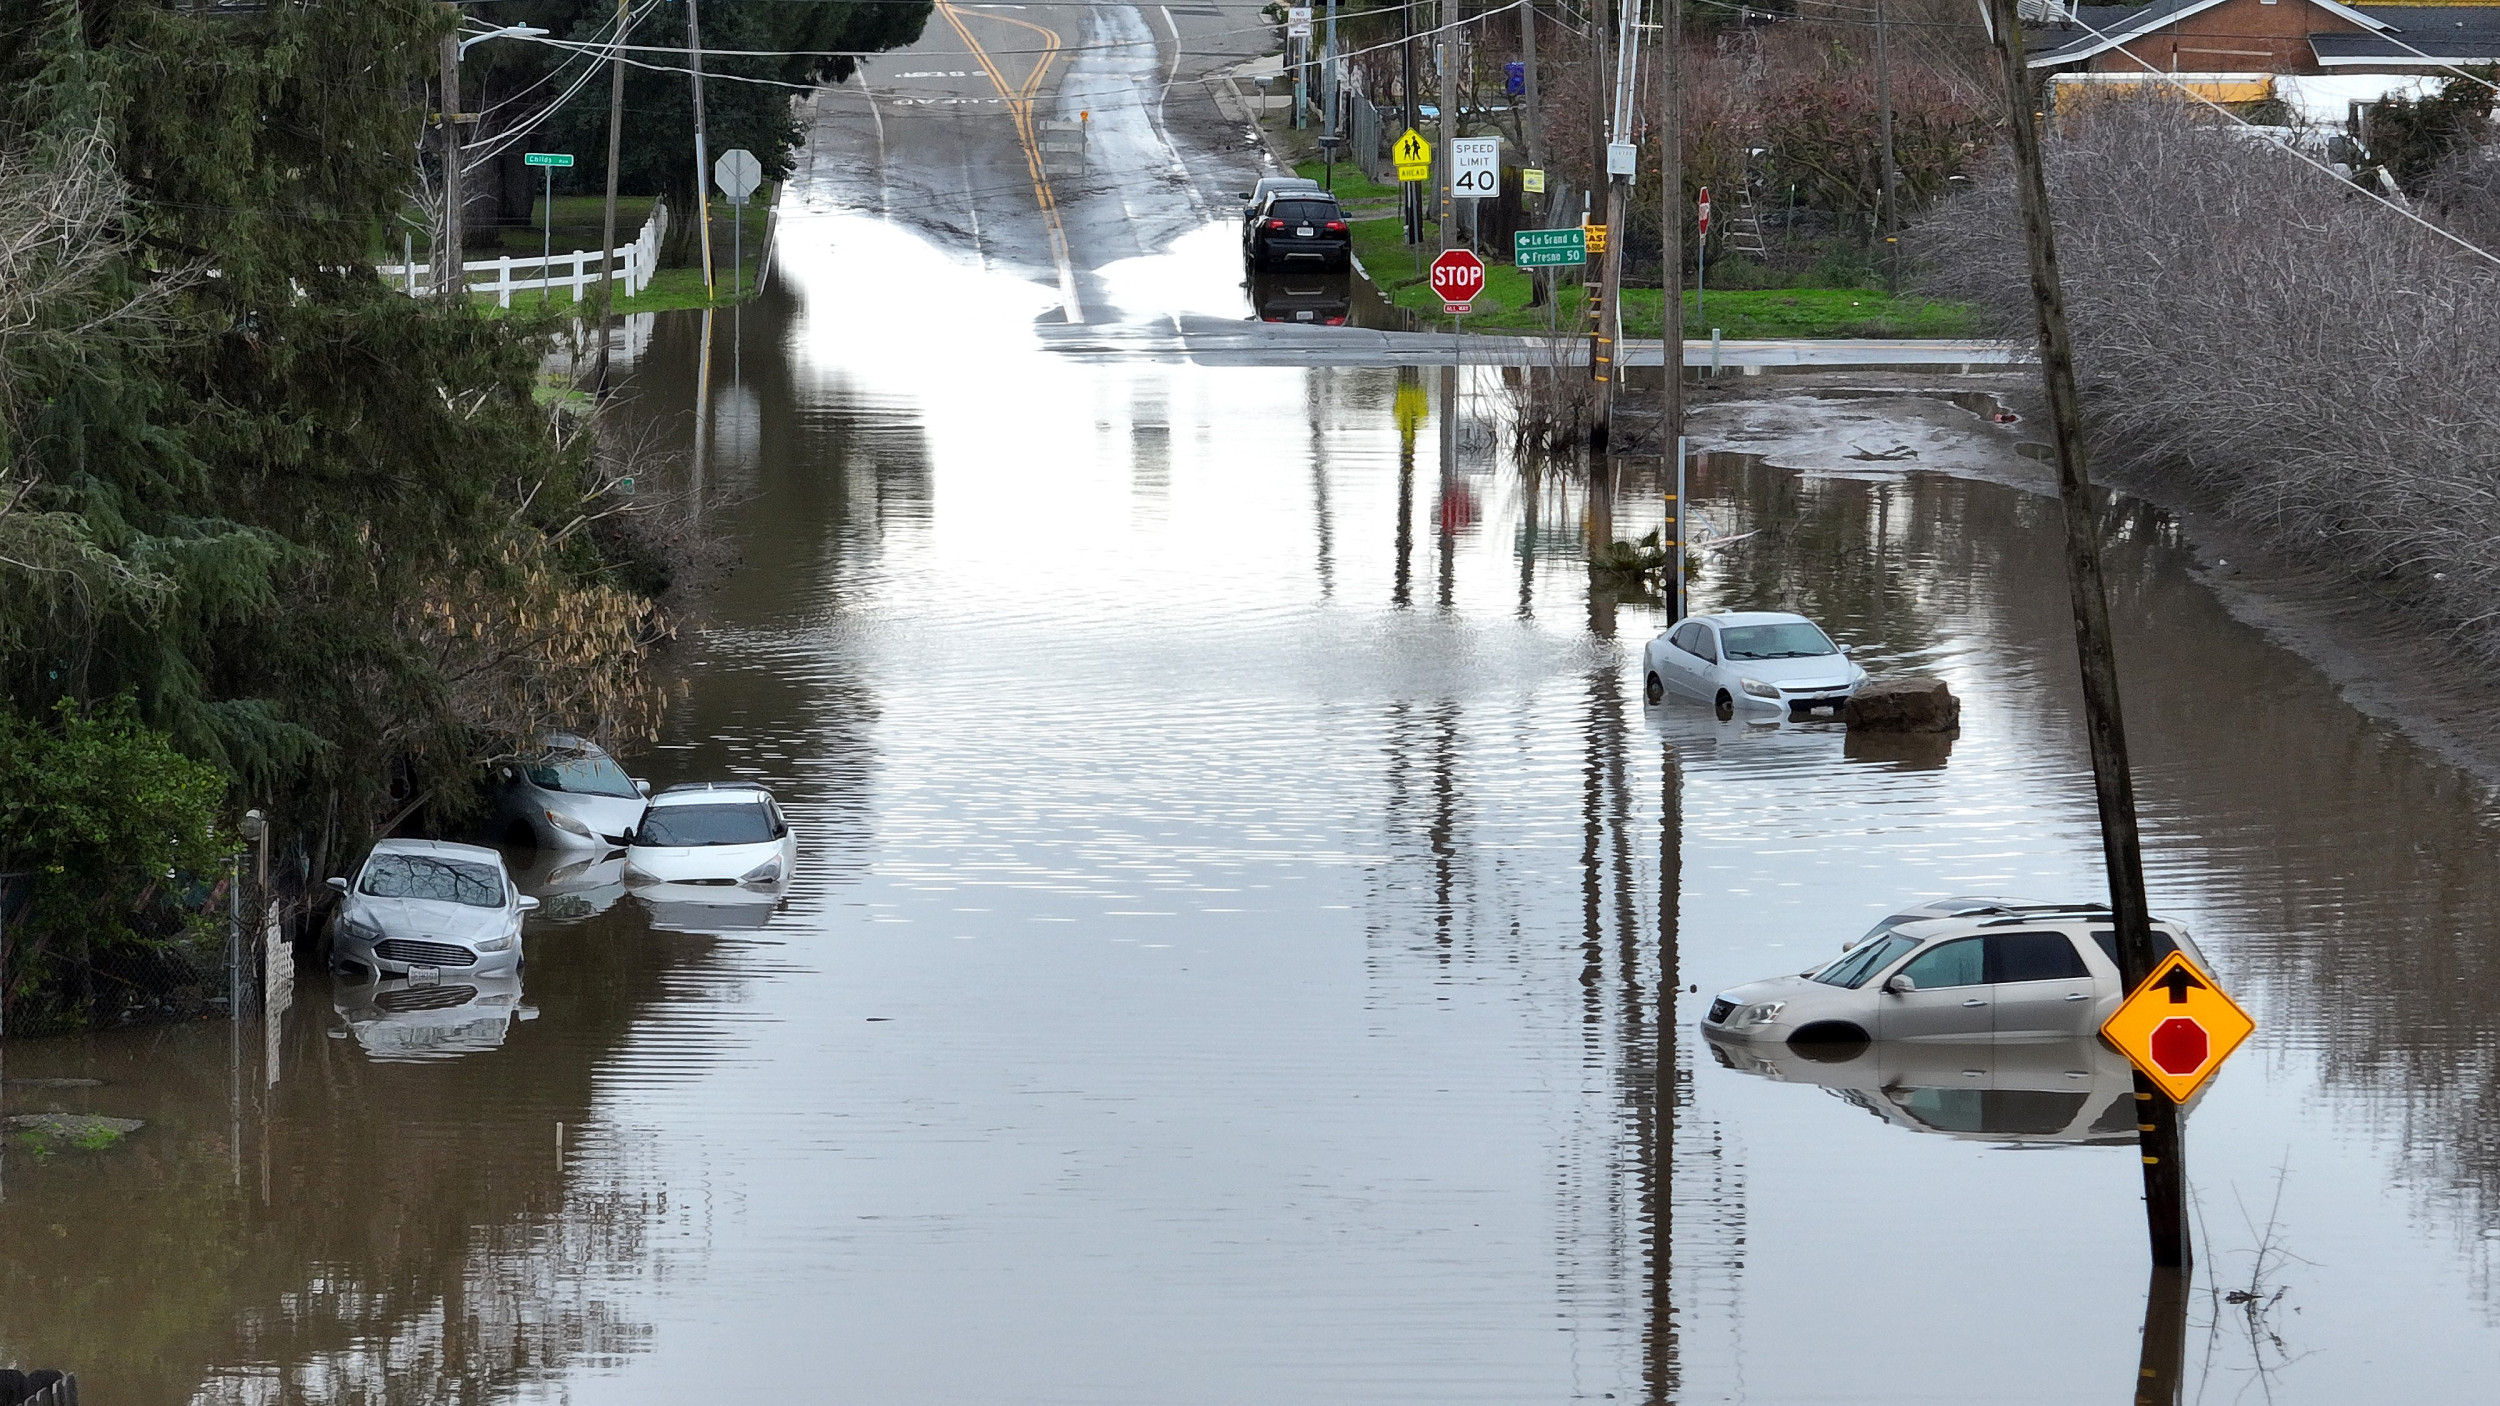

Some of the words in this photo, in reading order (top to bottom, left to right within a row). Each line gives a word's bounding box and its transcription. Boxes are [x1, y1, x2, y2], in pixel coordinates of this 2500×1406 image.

[1456, 144, 1494, 153] SPEED
[1460, 157, 1490, 166] LIMIT
[1401, 168, 1425, 177] AHEAD
[1456, 170, 1495, 190] 40
[1531, 235, 1542, 245] Le
[1543, 234, 1568, 245] Grand
[1572, 234, 1579, 244] 6
[1532, 251, 1561, 262] Fresno
[1566, 250, 1580, 261] 50
[1434, 266, 1481, 286] STOP
